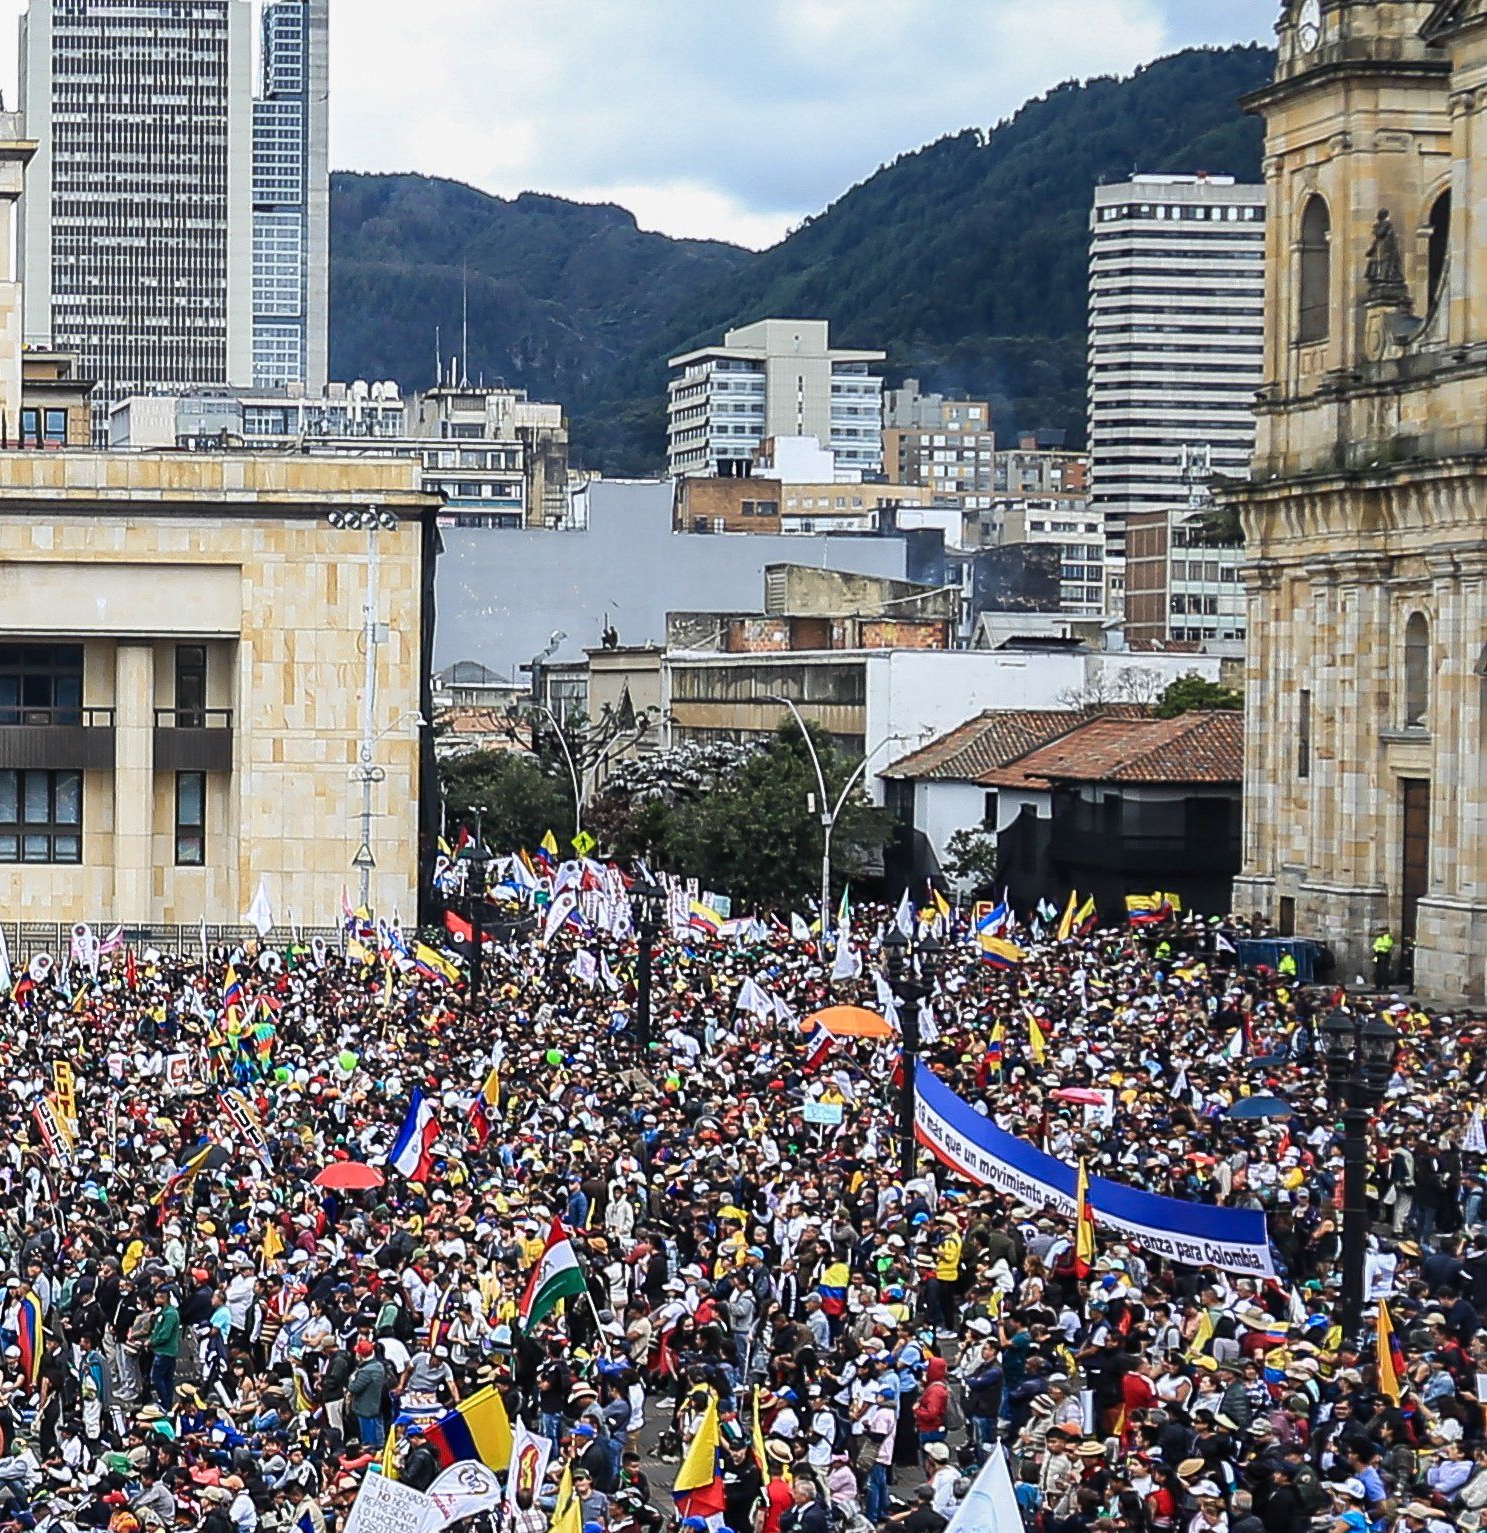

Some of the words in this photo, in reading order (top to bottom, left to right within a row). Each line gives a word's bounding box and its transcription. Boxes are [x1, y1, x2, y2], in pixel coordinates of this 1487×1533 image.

[55, 1063, 71, 1117] CUT
[225, 1092, 262, 1148] CUT
[945, 1132, 962, 1158] que
[964, 1146, 978, 1168] un
[979, 1156, 1044, 1206] movimiento
[1176, 1240, 1203, 1263] para
[357, 1507, 371, 1519] LO
[363, 1494, 419, 1526] REPRESENTA
[378, 1490, 391, 1503] NO
[392, 1496, 410, 1511] NOS
